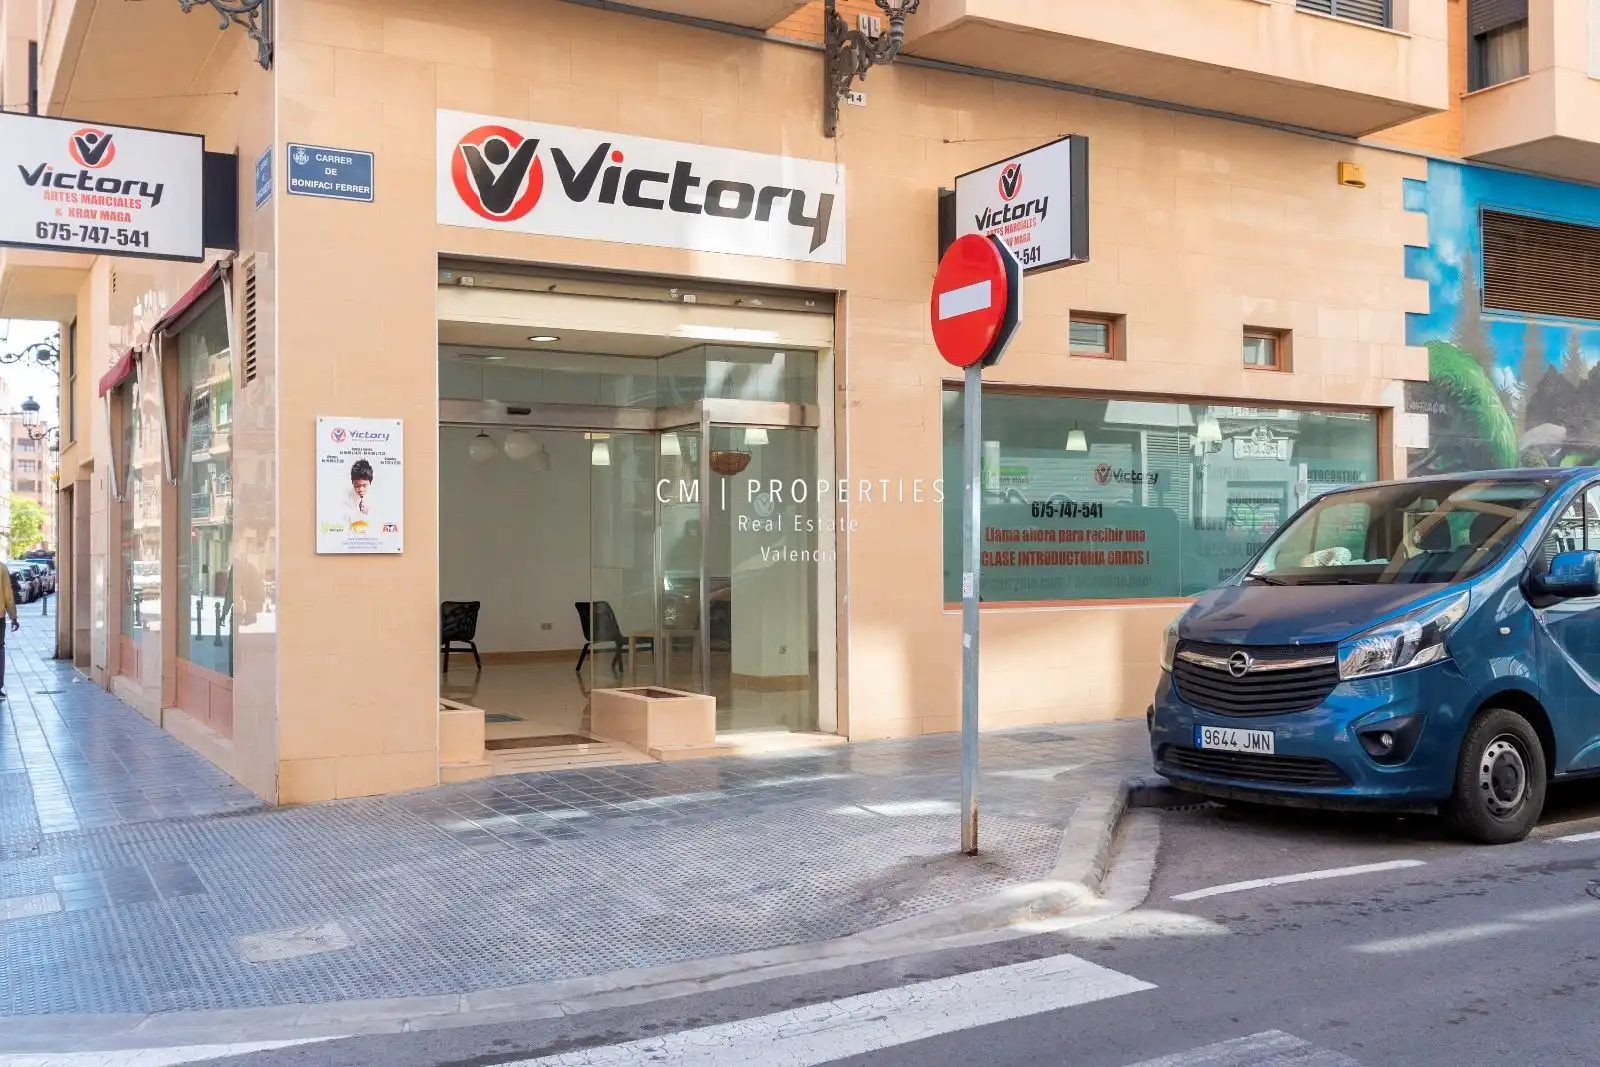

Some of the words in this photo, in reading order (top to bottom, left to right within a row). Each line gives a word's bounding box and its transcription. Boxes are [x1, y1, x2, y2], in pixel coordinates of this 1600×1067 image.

[315, 153, 353, 165] CARRER
[324, 167, 338, 176] DE
[17, 162, 164, 208] Victory
[291, 178, 333, 190] BONIFACI
[335, 183, 371, 194] FERRER
[44, 190, 78, 204] ARTES
[80, 193, 142, 209] MARCIALES
[550, 142, 835, 254] Victory
[68, 207, 98, 220] KRAV
[100, 210, 132, 223] MAGA
[974, 196, 1049, 231] Victory
[1004, 217, 1037, 234] MARCIALES
[36, 221, 149, 248] 675-747-541
[350, 430, 390, 441] Victory
[1031, 501, 1103, 519] 675-747-541
[985, 527, 1020, 542] Llama
[1022, 527, 1056, 542] ahora
[1058, 529, 1084, 544] para
[1086, 527, 1124, 542] recibir
[1125, 529, 1146, 542] una
[981, 551, 1015, 566] CLASE
[1018, 551, 1105, 566] INTRODUCTORIA
[1107, 551, 1144, 566] GRATIS
[1204, 729, 1237, 747] 9644
[1243, 732, 1270, 750] JMN
